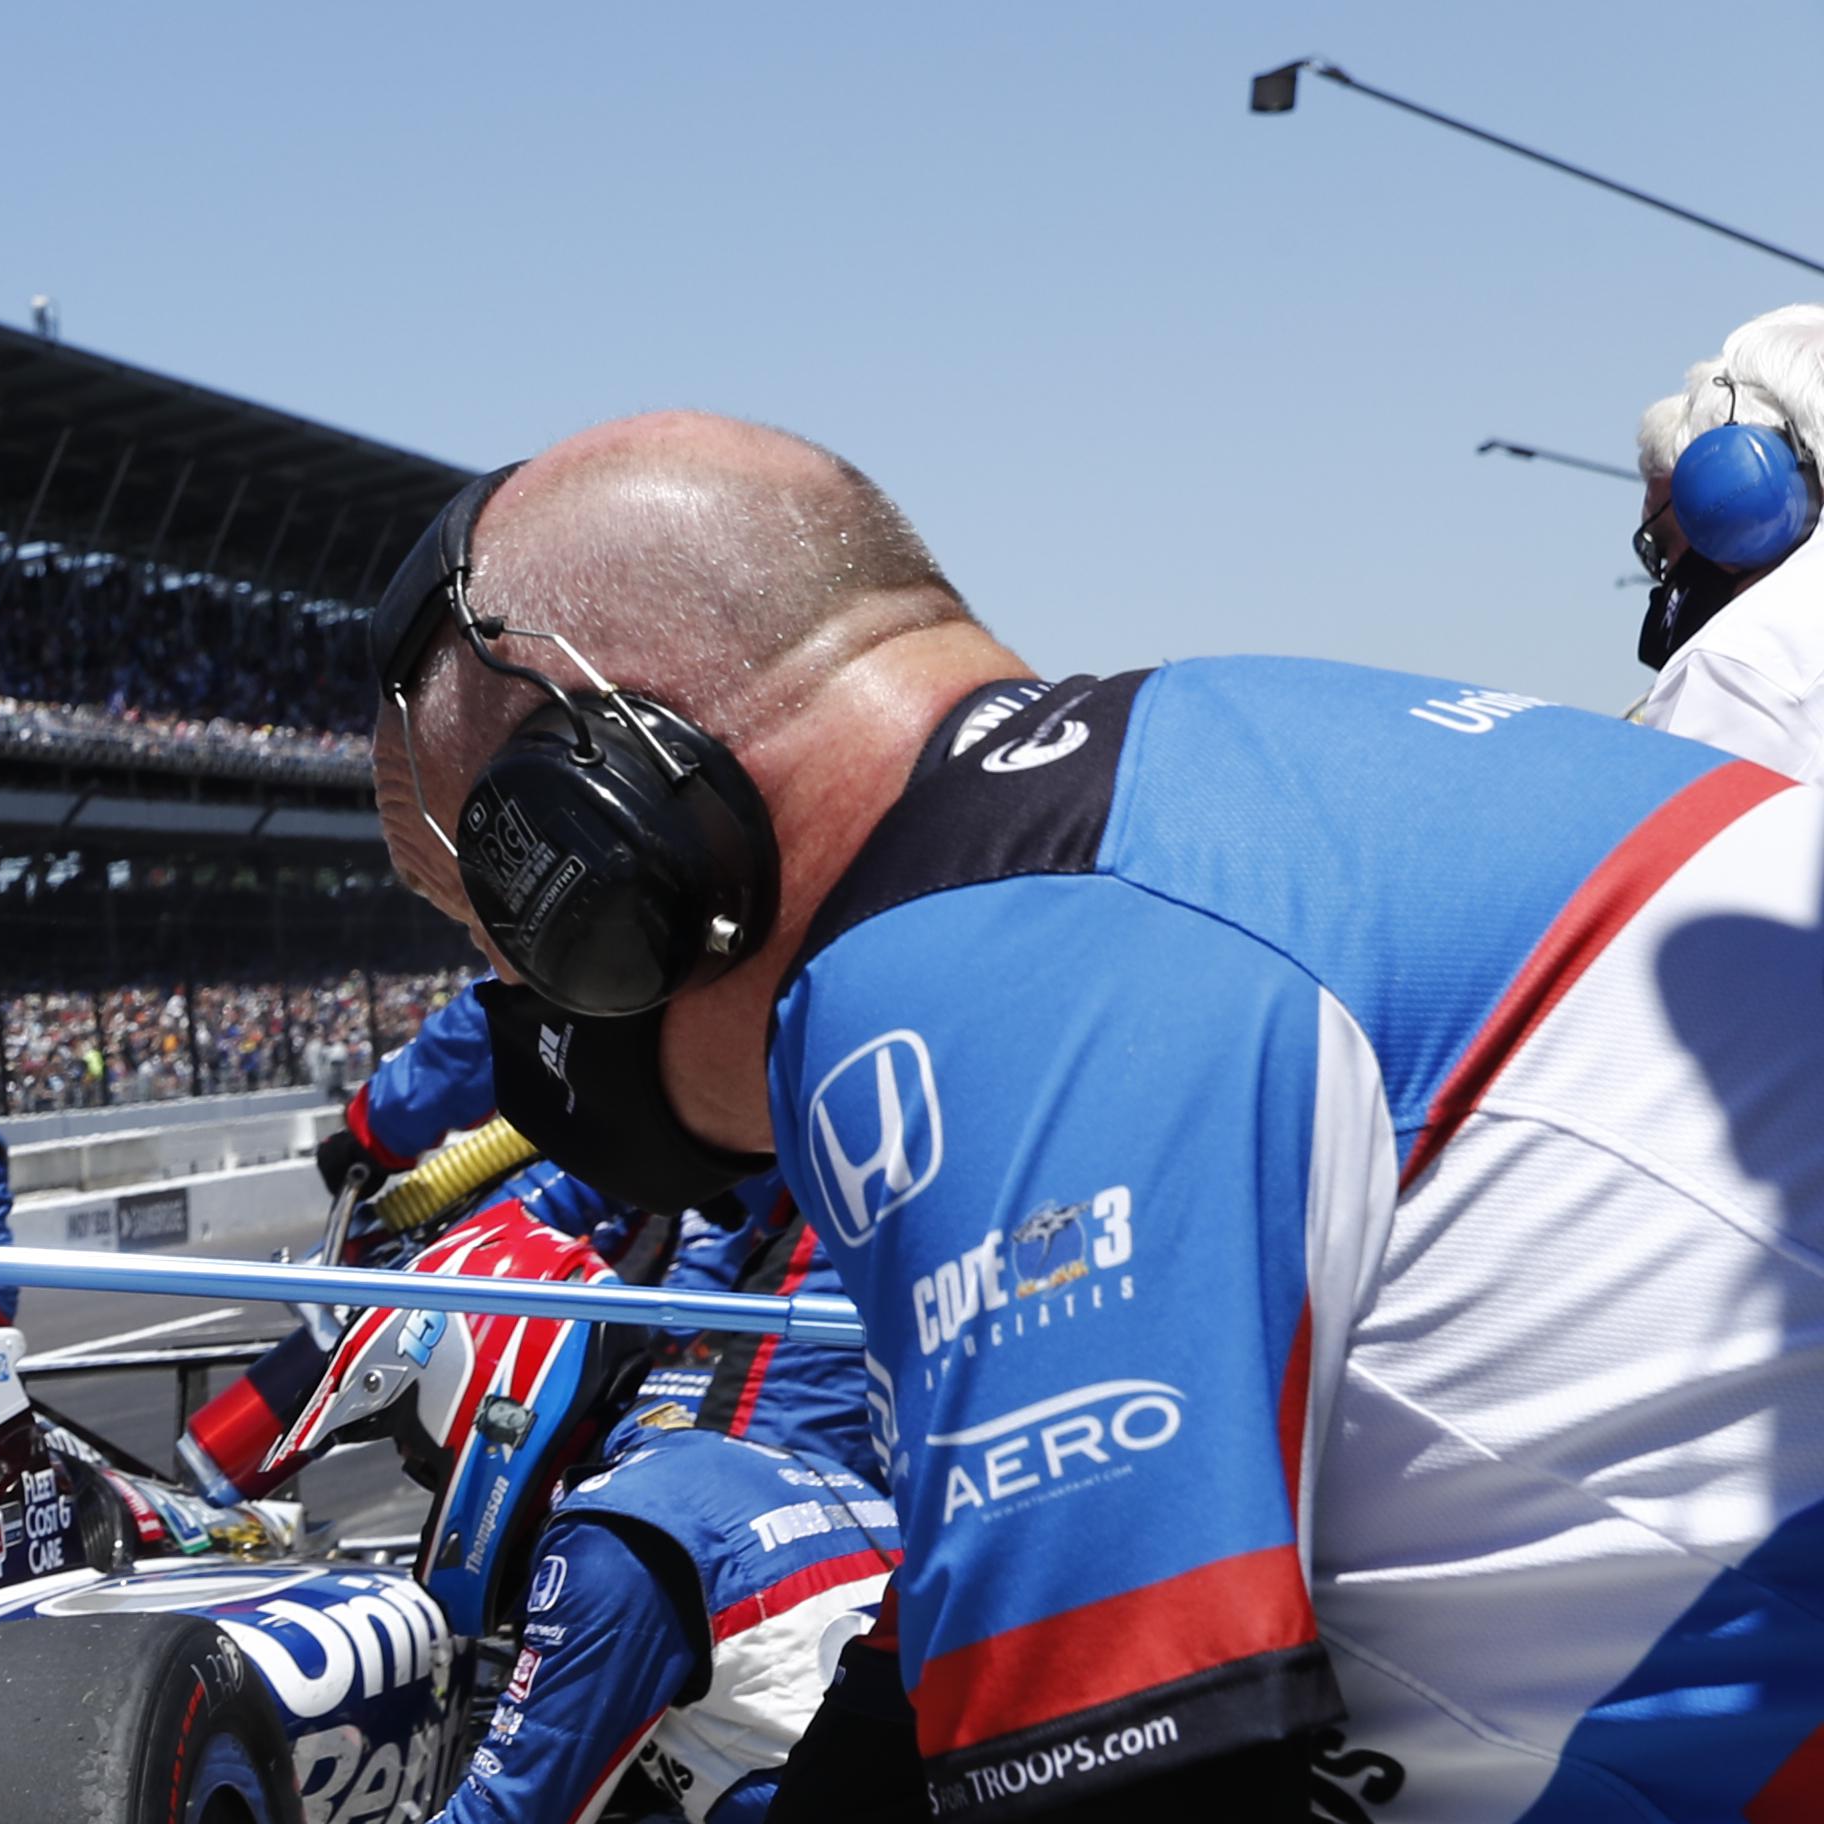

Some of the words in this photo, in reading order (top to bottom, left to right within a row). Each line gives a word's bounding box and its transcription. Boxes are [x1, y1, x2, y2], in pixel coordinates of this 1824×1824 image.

[1092, 1184, 1133, 1270] 3
[396, 1309, 448, 1368] 15
[21, 1467, 56, 1505] FLEET
[943, 1394, 1182, 1526] AERO
[464, 1475, 511, 1575] Thompson
[964, 1713, 1180, 1806] TROOPS.com
